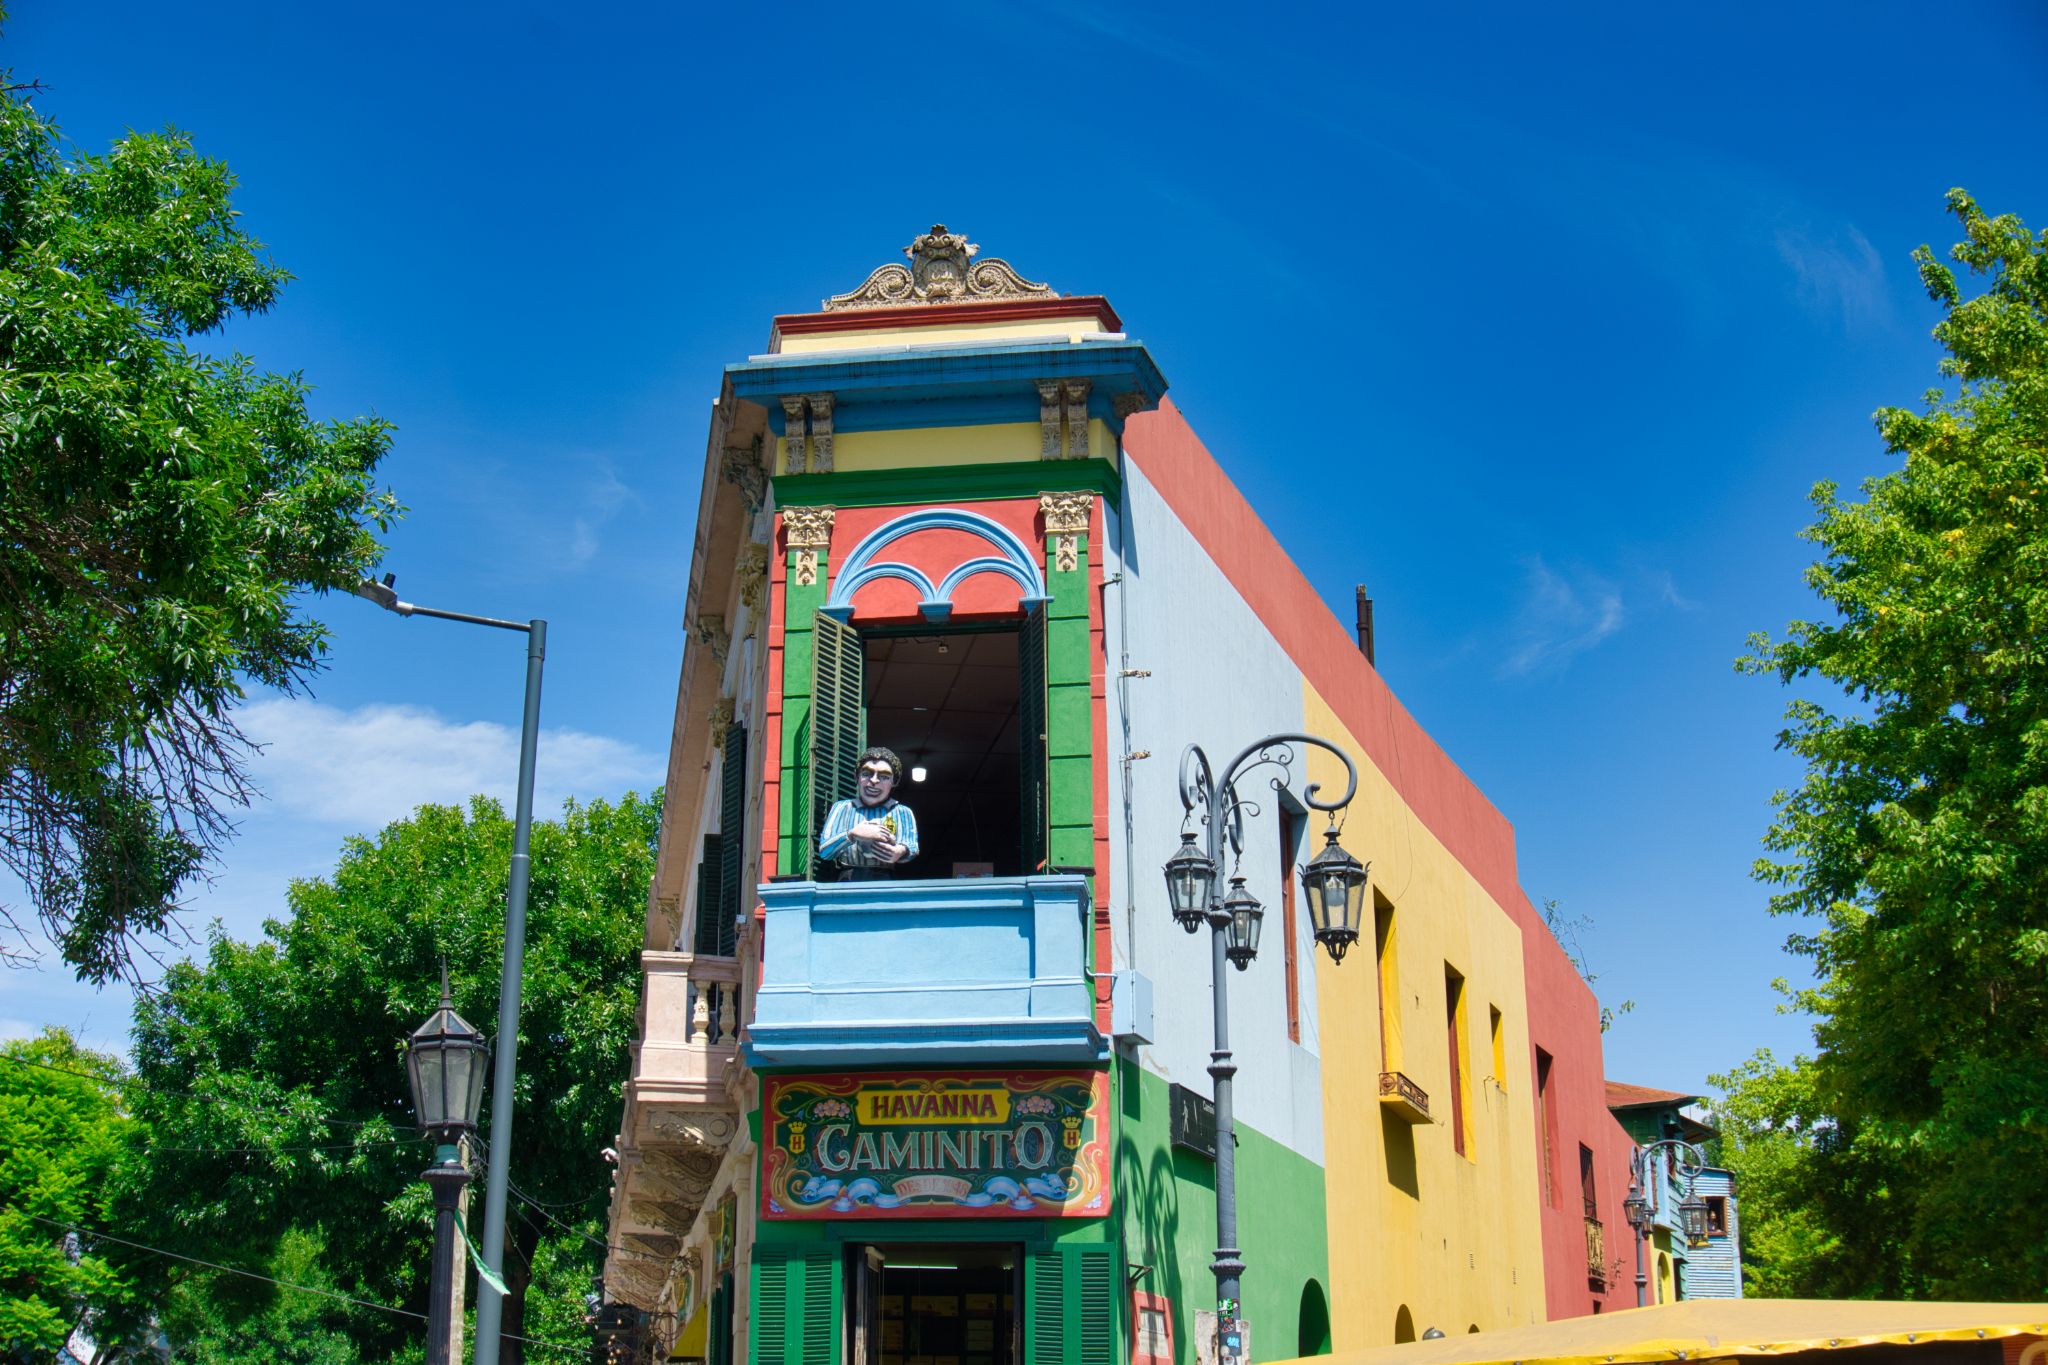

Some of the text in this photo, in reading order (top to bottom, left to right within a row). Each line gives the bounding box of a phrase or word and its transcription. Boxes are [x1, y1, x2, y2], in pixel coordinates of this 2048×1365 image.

[871, 1094, 998, 1118] HAVANNA
[792, 1136, 802, 1150] H
[816, 1121, 1054, 1171] CAMINITO
[1067, 1131, 1077, 1145] H
